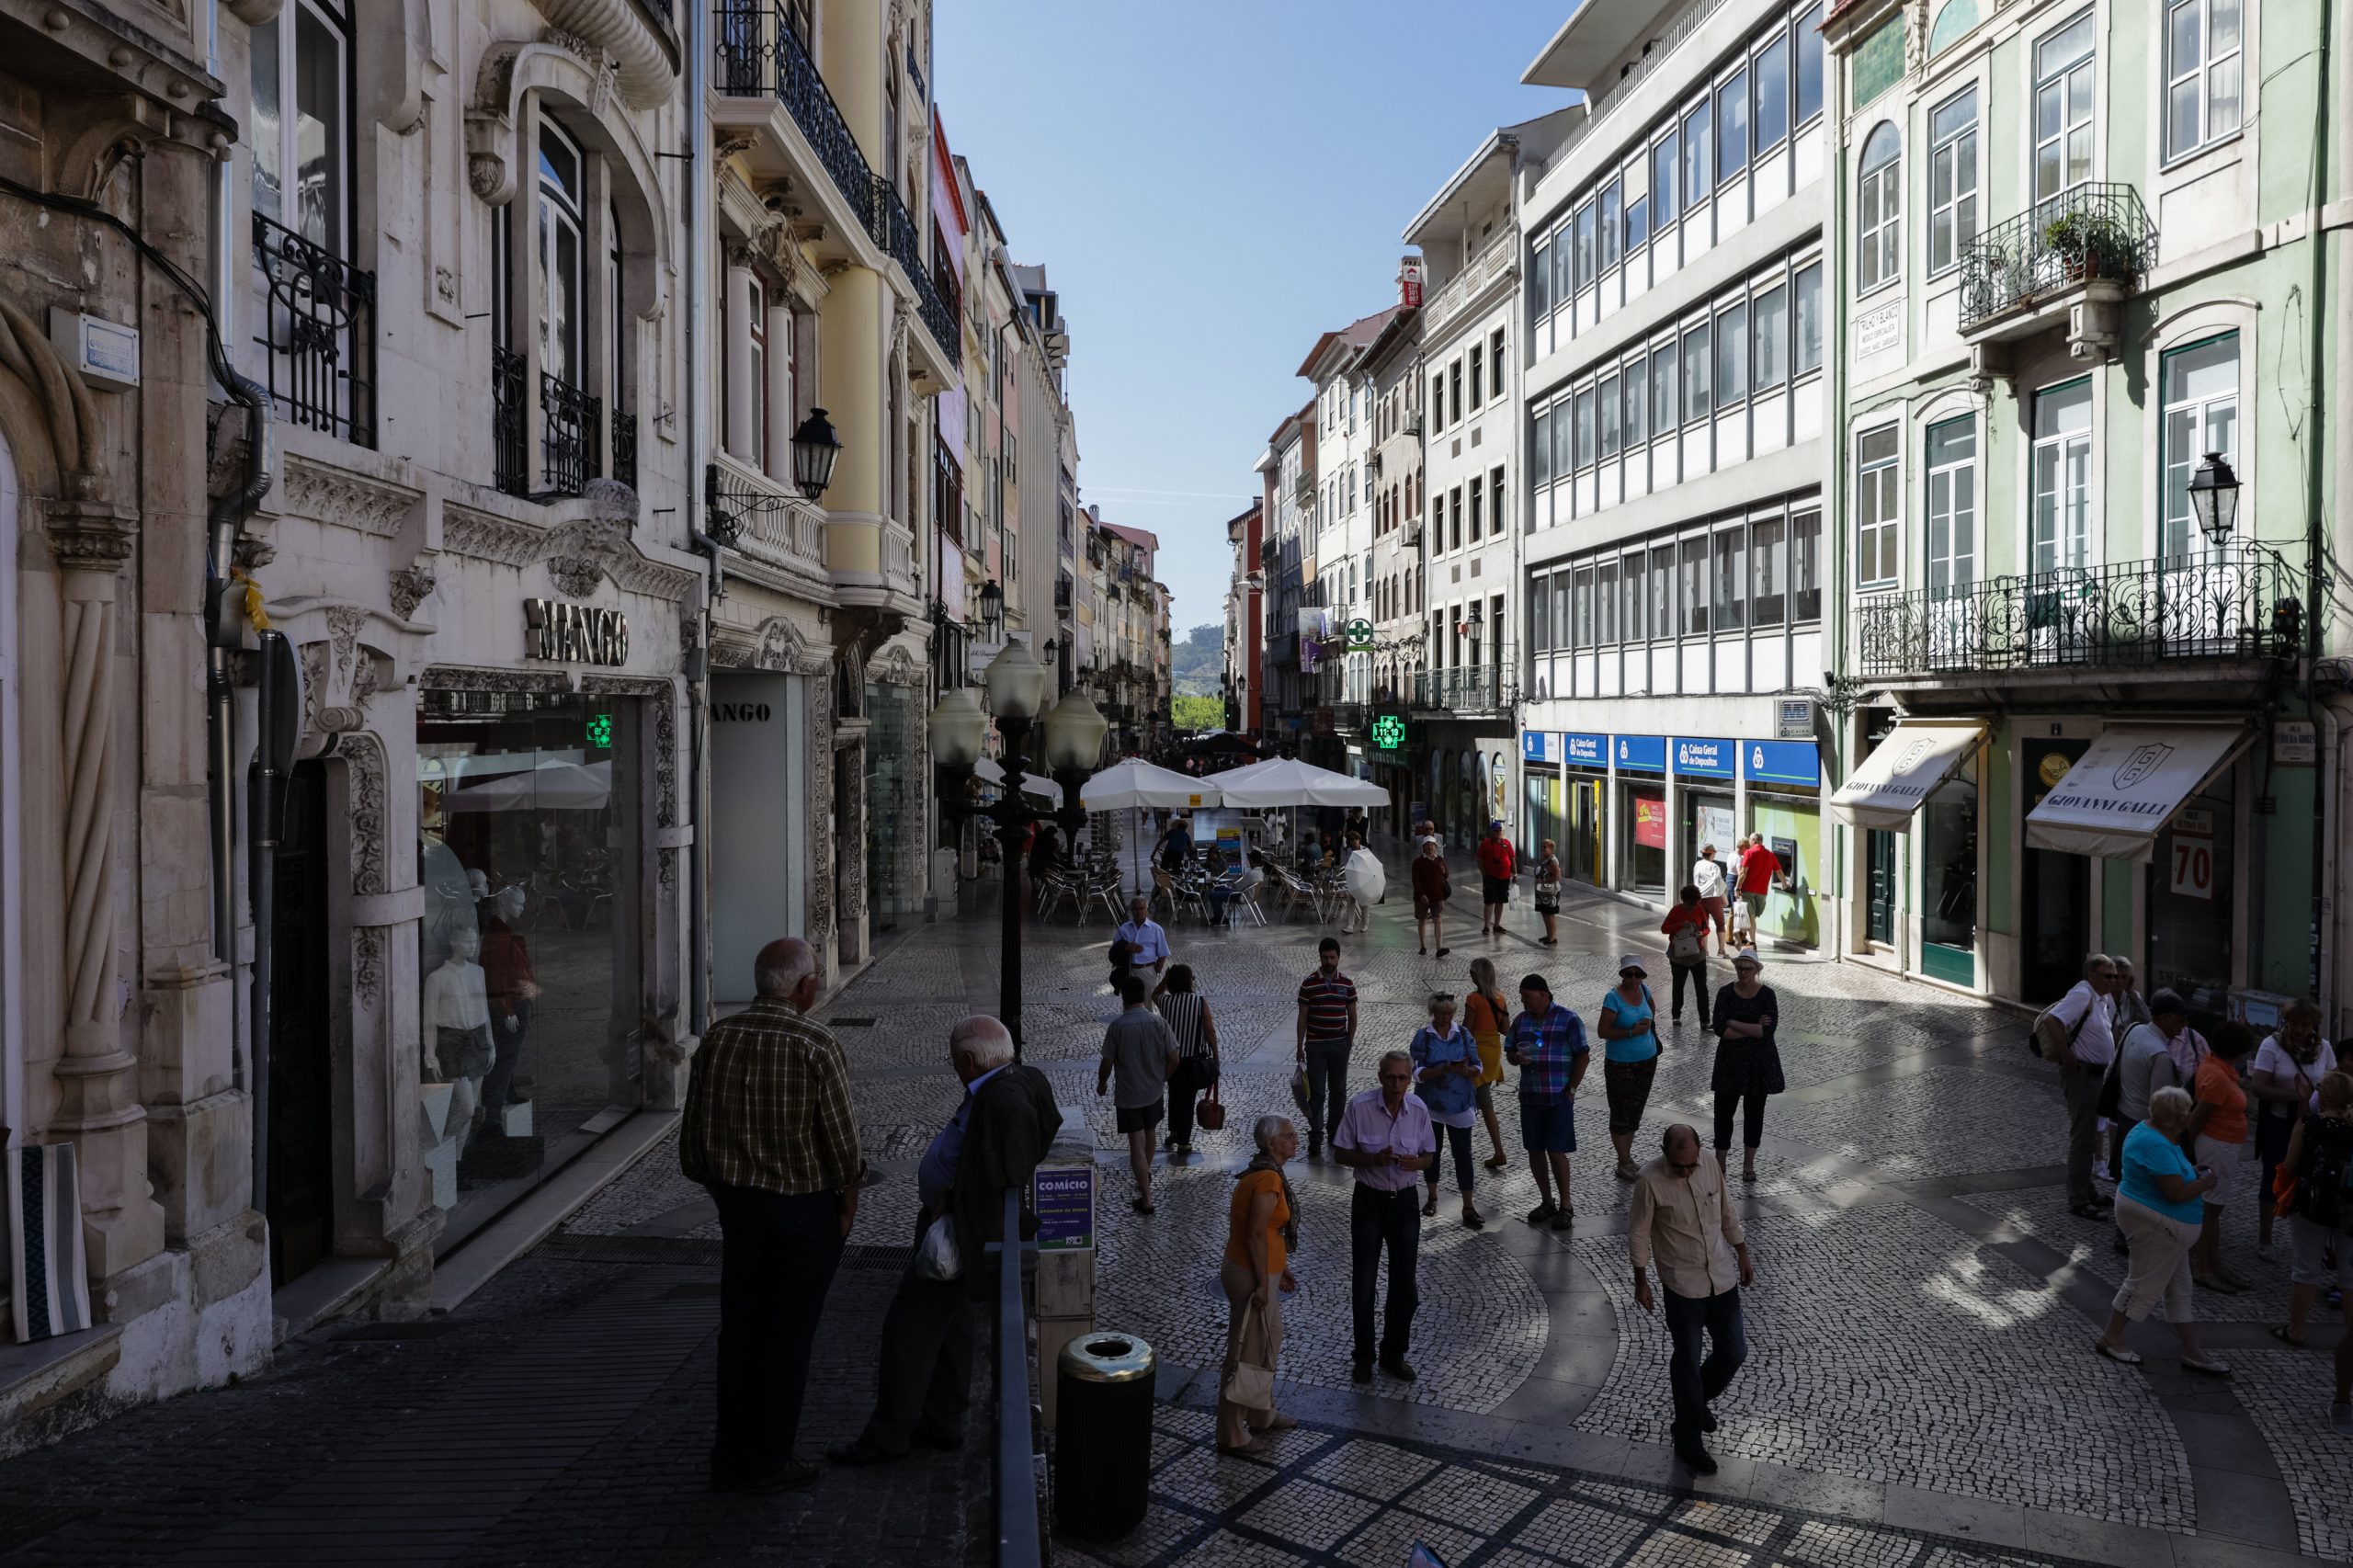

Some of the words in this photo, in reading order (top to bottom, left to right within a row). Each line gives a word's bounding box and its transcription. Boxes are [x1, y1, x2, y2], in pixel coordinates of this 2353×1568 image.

[524, 597, 629, 666] MANGO
[710, 703, 770, 722] ANGO
[1379, 728, 1398, 736] 11:19
[1576, 739, 1586, 747] Caixa
[1586, 739, 1597, 748] Geral
[1689, 744, 1702, 754] Caixa
[1703, 744, 1718, 756] Geral
[1689, 756, 1694, 765] de
[1846, 781, 1893, 794] GIOVANNI
[1892, 785, 1925, 797] GALLI
[2048, 794, 2118, 811] GIOVANNI
[2118, 801, 2168, 816] GALLI
[2176, 844, 2210, 890] 70
[1039, 1178, 1088, 1191] COMÍCIO
